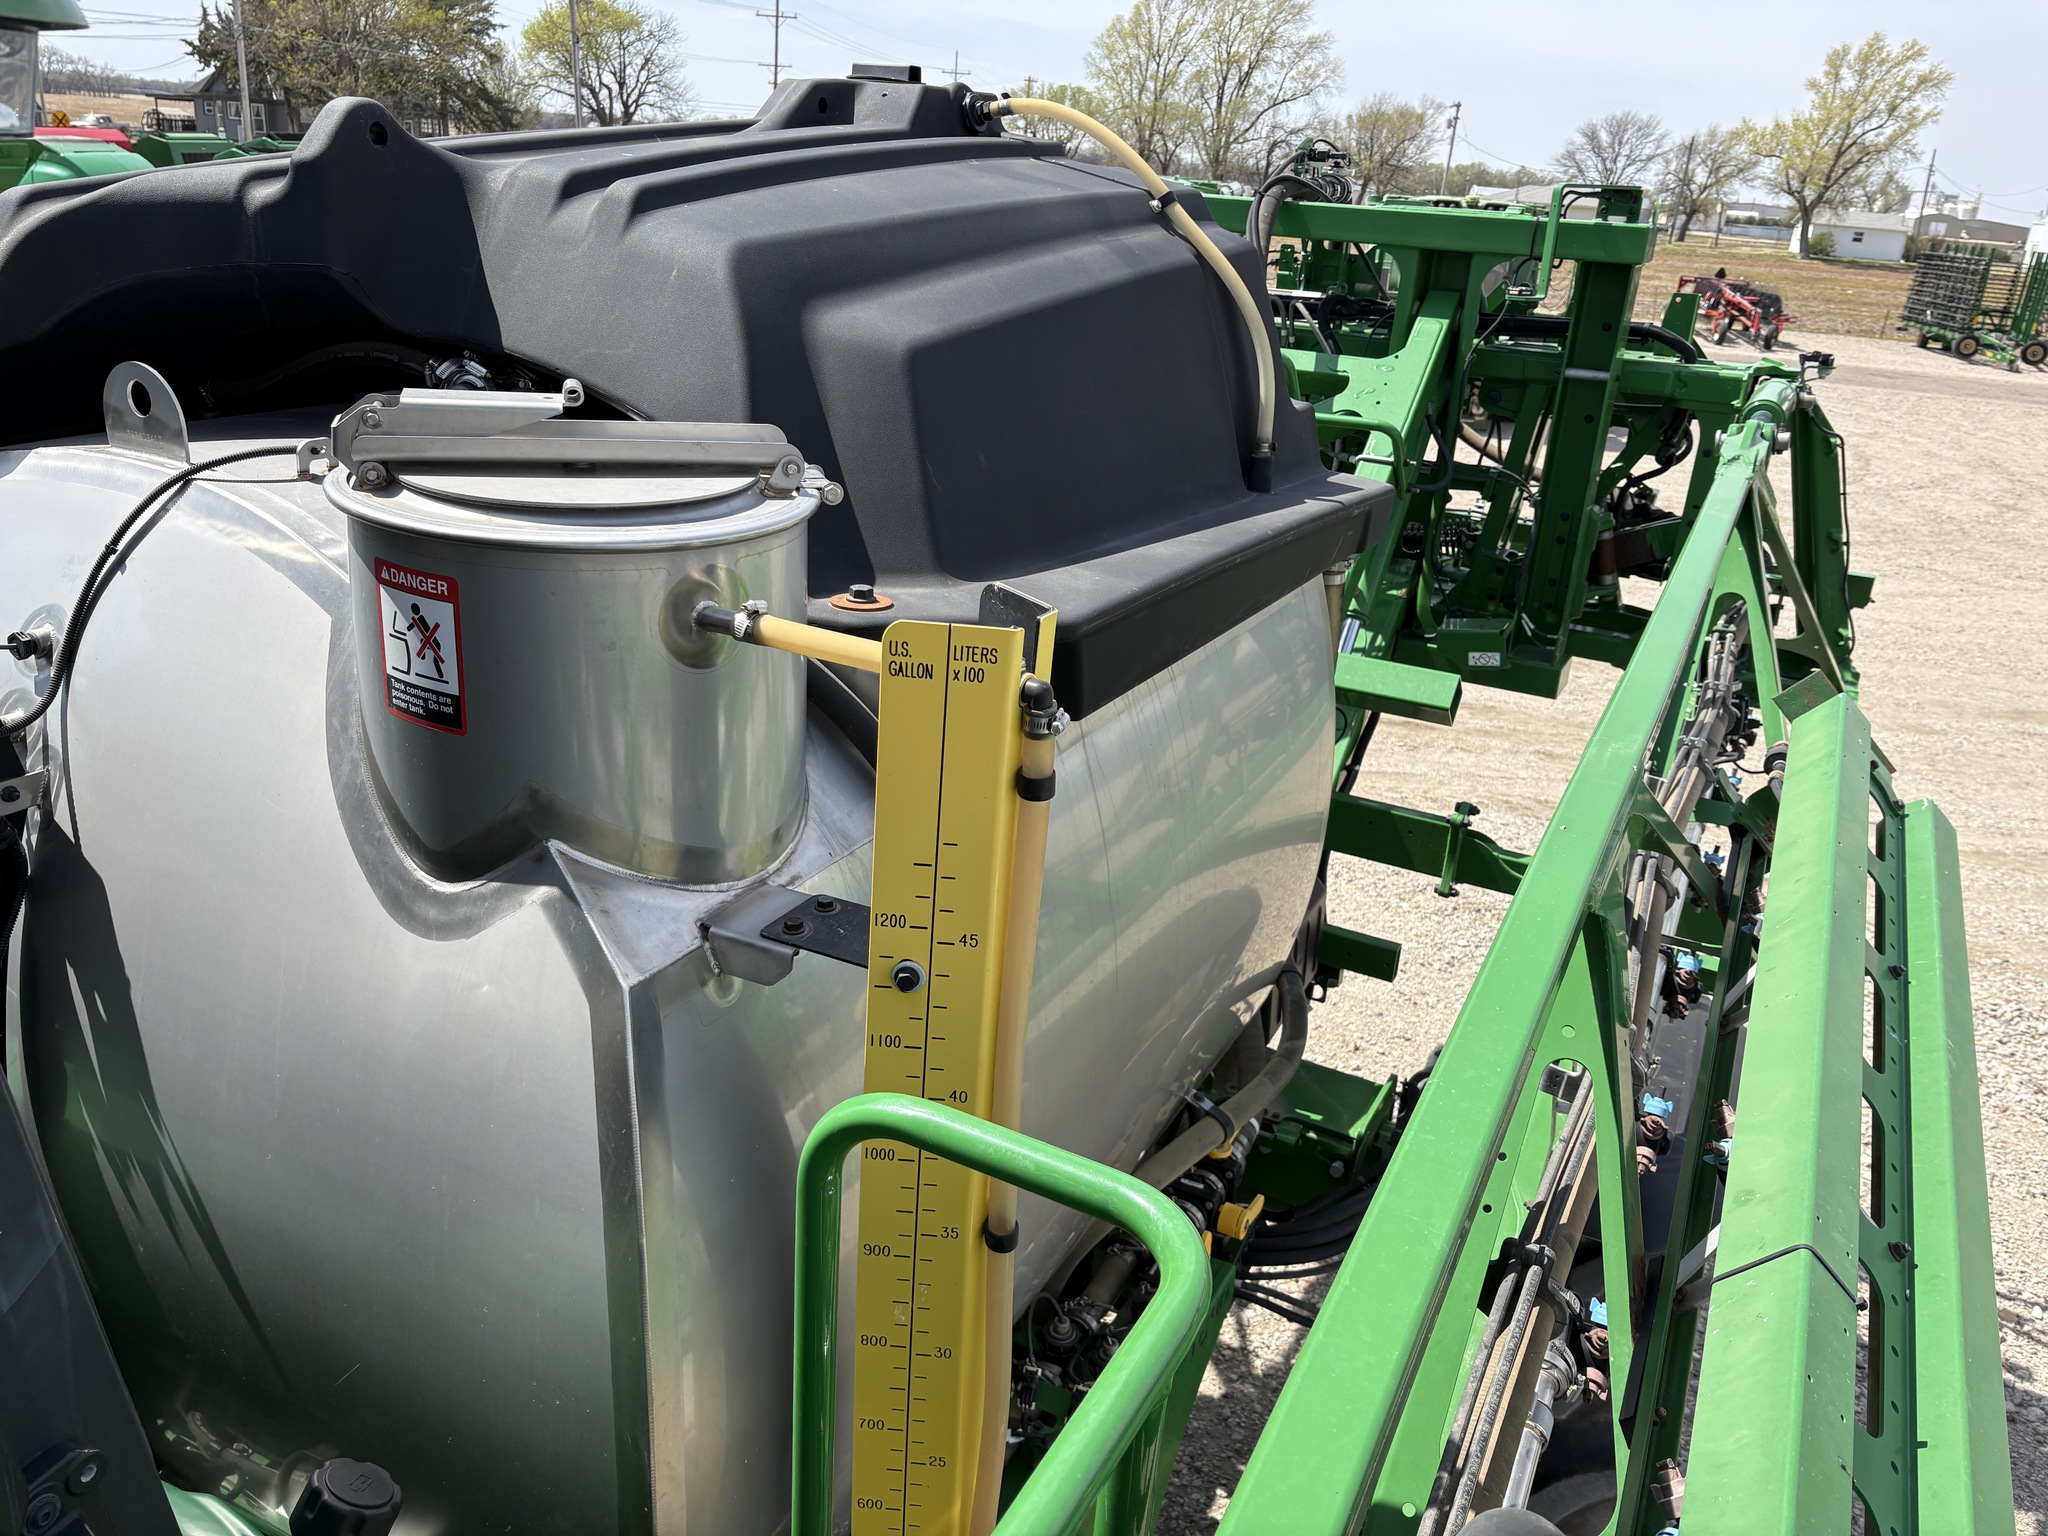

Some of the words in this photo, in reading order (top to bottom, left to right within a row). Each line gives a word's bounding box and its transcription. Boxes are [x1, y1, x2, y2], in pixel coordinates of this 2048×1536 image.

[391, 568, 448, 596] DANGER
[888, 640, 912, 658] U.S.
[953, 645, 998, 665] LITERS
[888, 661, 934, 680] GALLON
[391, 678, 406, 691] Tank
[406, 686, 437, 701] contents
[438, 696, 452, 705] are
[392, 689, 426, 707] poisonous.
[428, 700, 439, 710] Do
[440, 705, 454, 714] not
[392, 698, 408, 709] enter
[409, 704, 427, 716] tank.
[874, 913, 907, 929] 1200
[958, 934, 979, 948] 45
[870, 1033, 901, 1049] 1100
[949, 1090, 968, 1103] 40
[865, 1147, 895, 1161] 1000
[940, 1226, 959, 1239] 35
[863, 1243, 891, 1257] 900
[860, 1334, 888, 1347] 800
[934, 1347, 952, 1359] 30
[859, 1418, 885, 1430] 700
[928, 1455, 947, 1468] 25
[857, 1498, 883, 1510] 600
